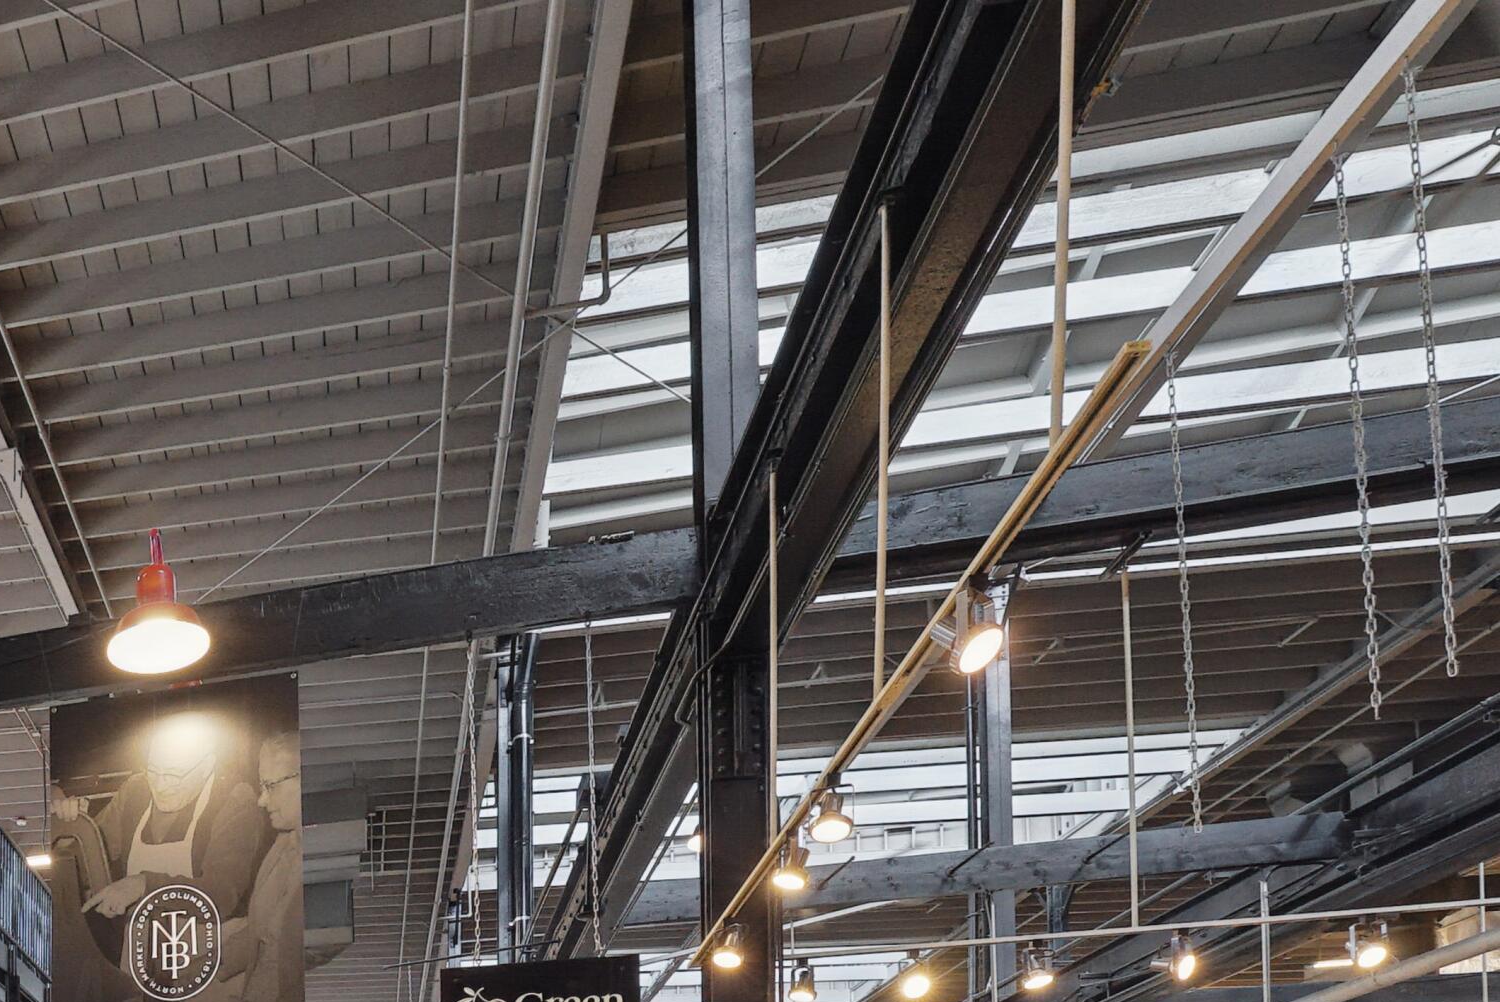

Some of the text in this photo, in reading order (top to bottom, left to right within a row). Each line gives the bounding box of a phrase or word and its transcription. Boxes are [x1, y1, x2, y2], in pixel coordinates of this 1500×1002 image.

[162, 891, 213, 949] COLUMBUS OHIO
[136, 941, 184, 994] NORTH MARKET
